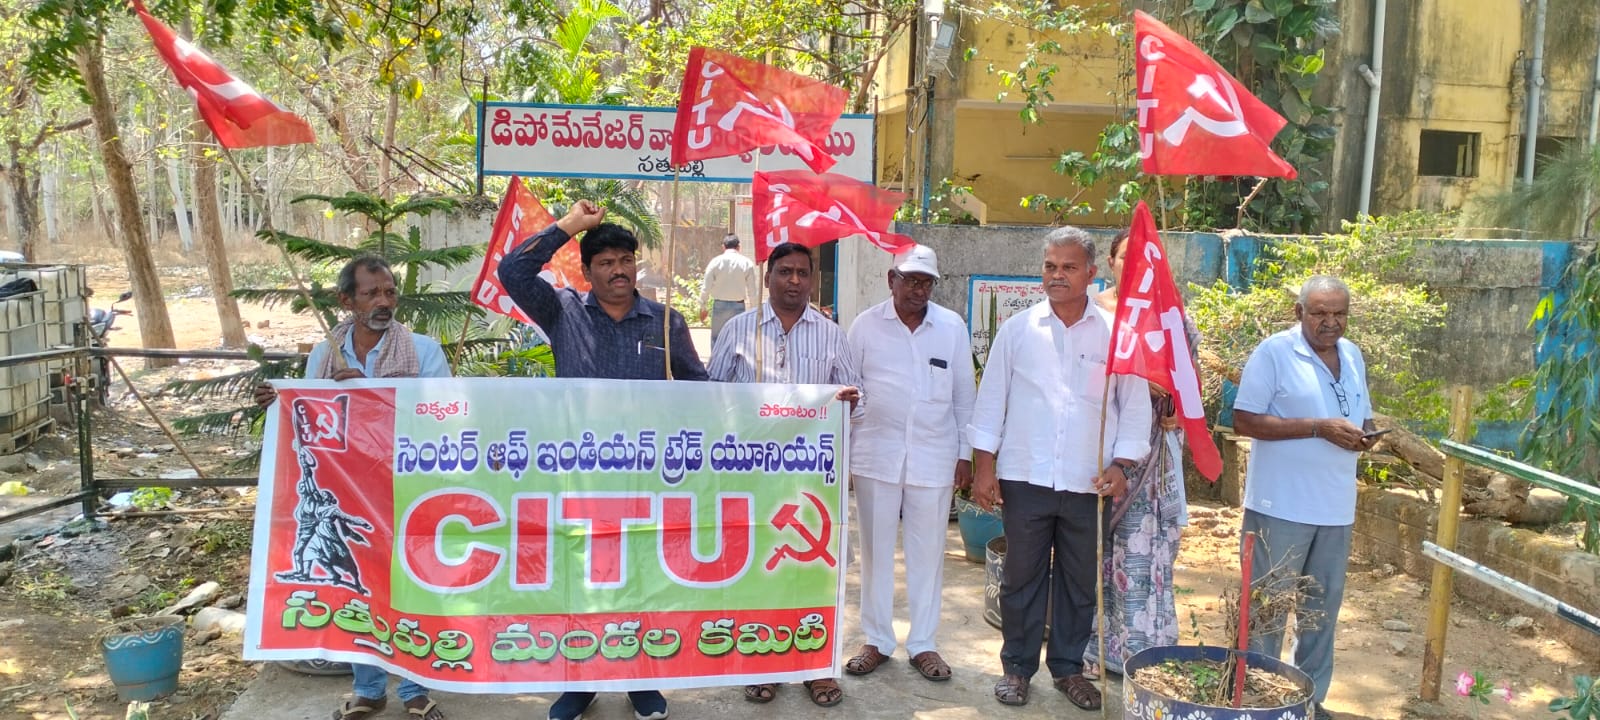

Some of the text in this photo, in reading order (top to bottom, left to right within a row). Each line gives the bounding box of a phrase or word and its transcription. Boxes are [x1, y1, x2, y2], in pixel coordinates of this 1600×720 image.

[490, 108, 549, 146] డిపో
[551, 110, 645, 150] మేనేజర్
[687, 60, 725, 149] CITU
[1115, 241, 1162, 359] CITU
[298, 404, 313, 442] CITU
[759, 403, 817, 419] పోరాటం
[397, 430, 479, 473] సెంటర్
[537, 430, 656, 472] ఇండియన్
[662, 429, 703, 484] ట్రేడ్
[710, 433, 836, 484] యూనియన్స్
[402, 491, 751, 590] CITU
[281, 590, 475, 671] సత్తుపల్లి
[491, 620, 682, 662] మండల
